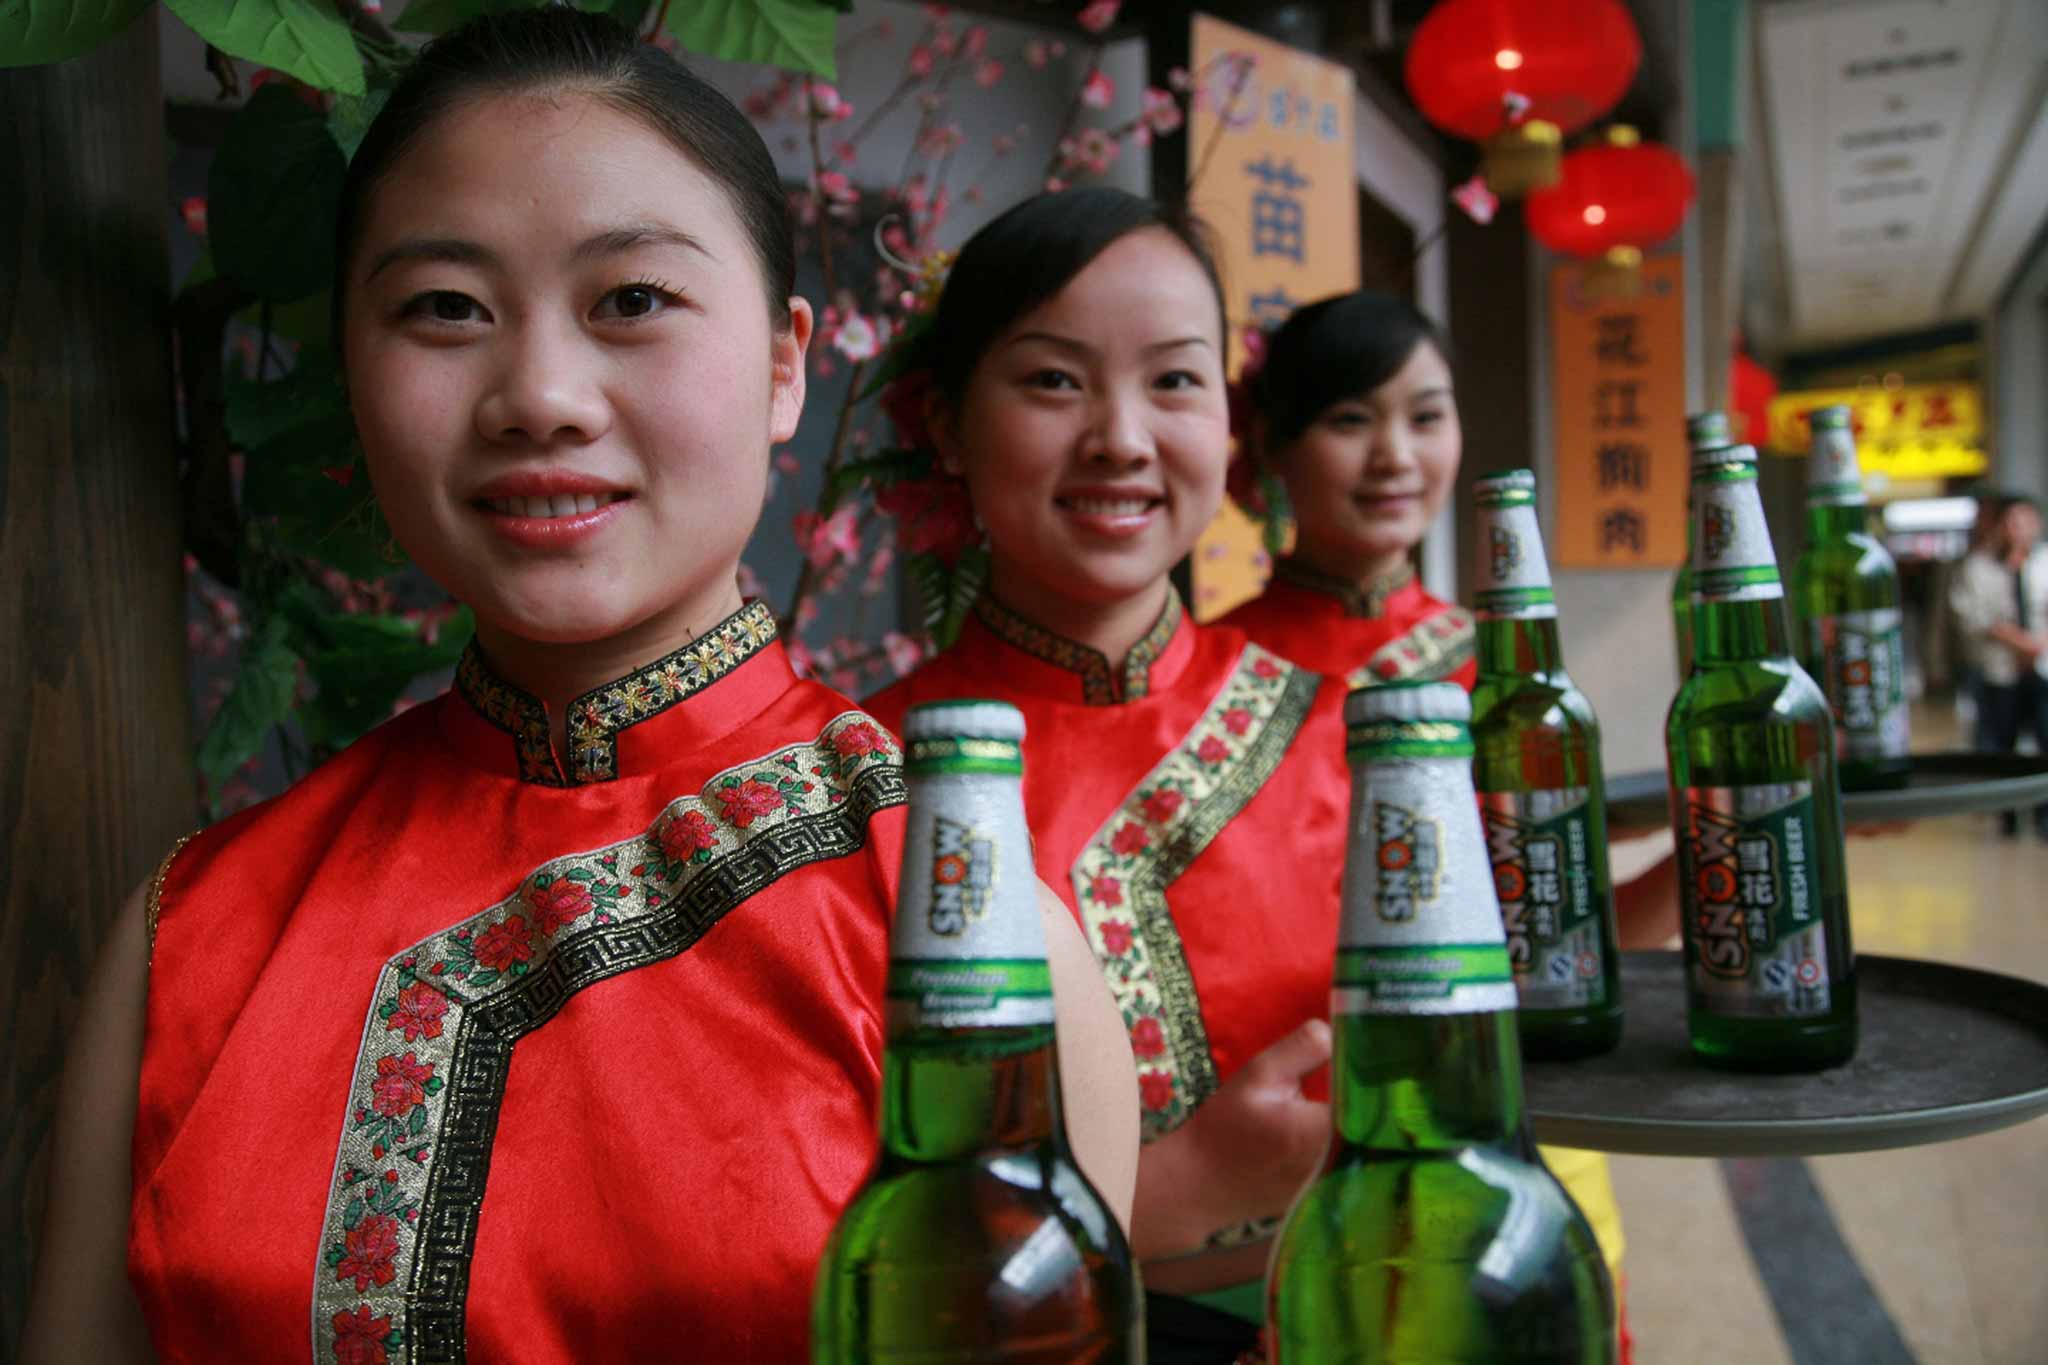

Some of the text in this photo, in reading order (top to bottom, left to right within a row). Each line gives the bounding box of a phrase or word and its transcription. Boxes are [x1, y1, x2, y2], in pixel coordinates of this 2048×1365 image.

[1594, 314, 1650, 554] 花江狗肉
[929, 815, 969, 937] SNOW
[1375, 801, 1416, 922] SNOW
[1488, 820, 1532, 965] SNOW
[1567, 818, 1586, 862] BEER
[1698, 815, 1743, 969] SNOW
[1784, 817, 1809, 920] FRESH BEER
